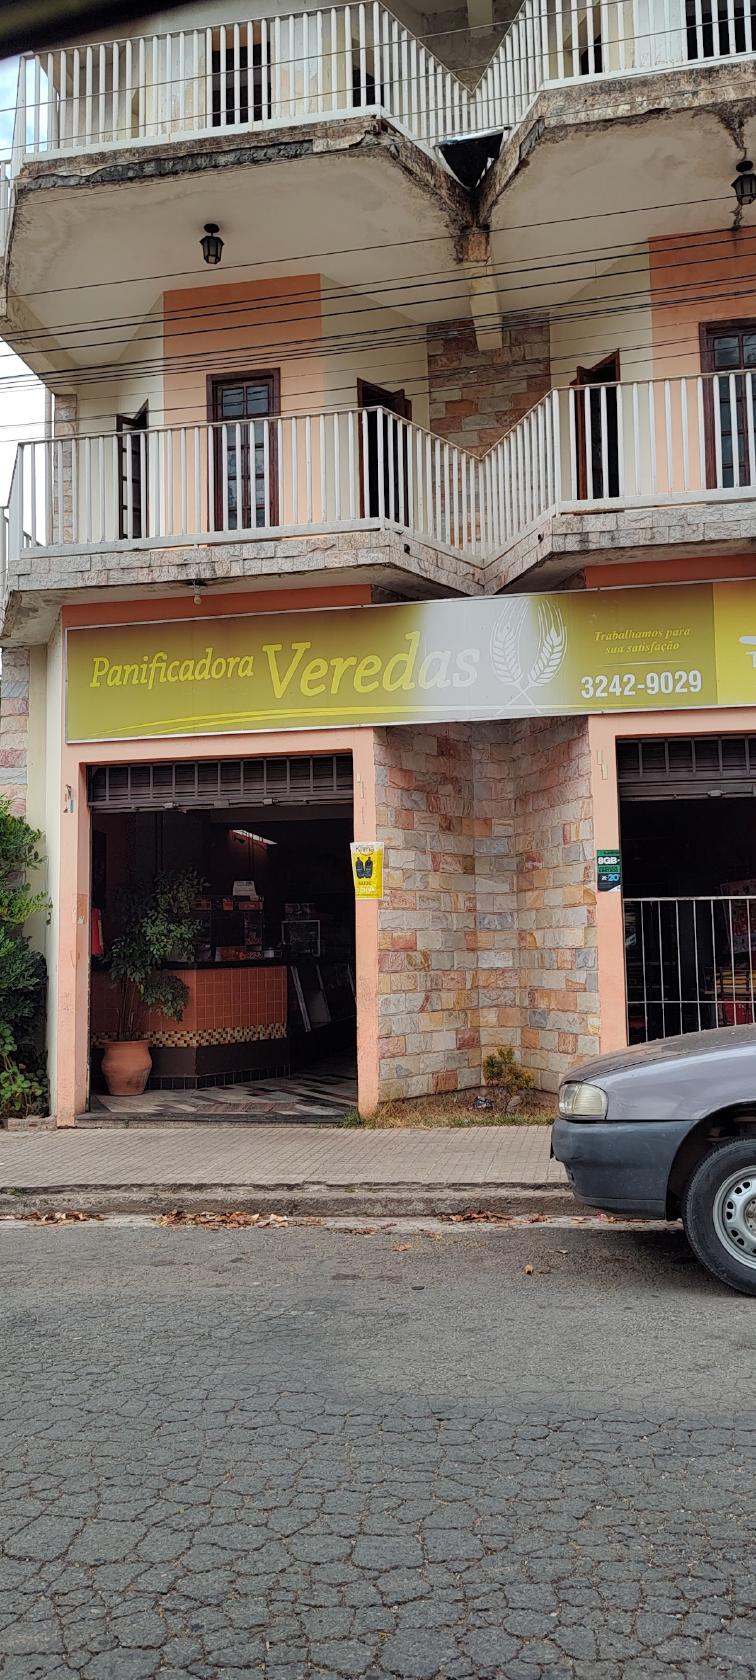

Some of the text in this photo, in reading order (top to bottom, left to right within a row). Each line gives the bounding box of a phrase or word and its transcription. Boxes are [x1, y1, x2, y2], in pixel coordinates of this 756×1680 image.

[594, 627, 690, 641] Trabalhamos para
[605, 640, 680, 654] sua satisfação
[90, 631, 480, 699] Panificadora Veredas
[580, 670, 702, 699] 3242-9029
